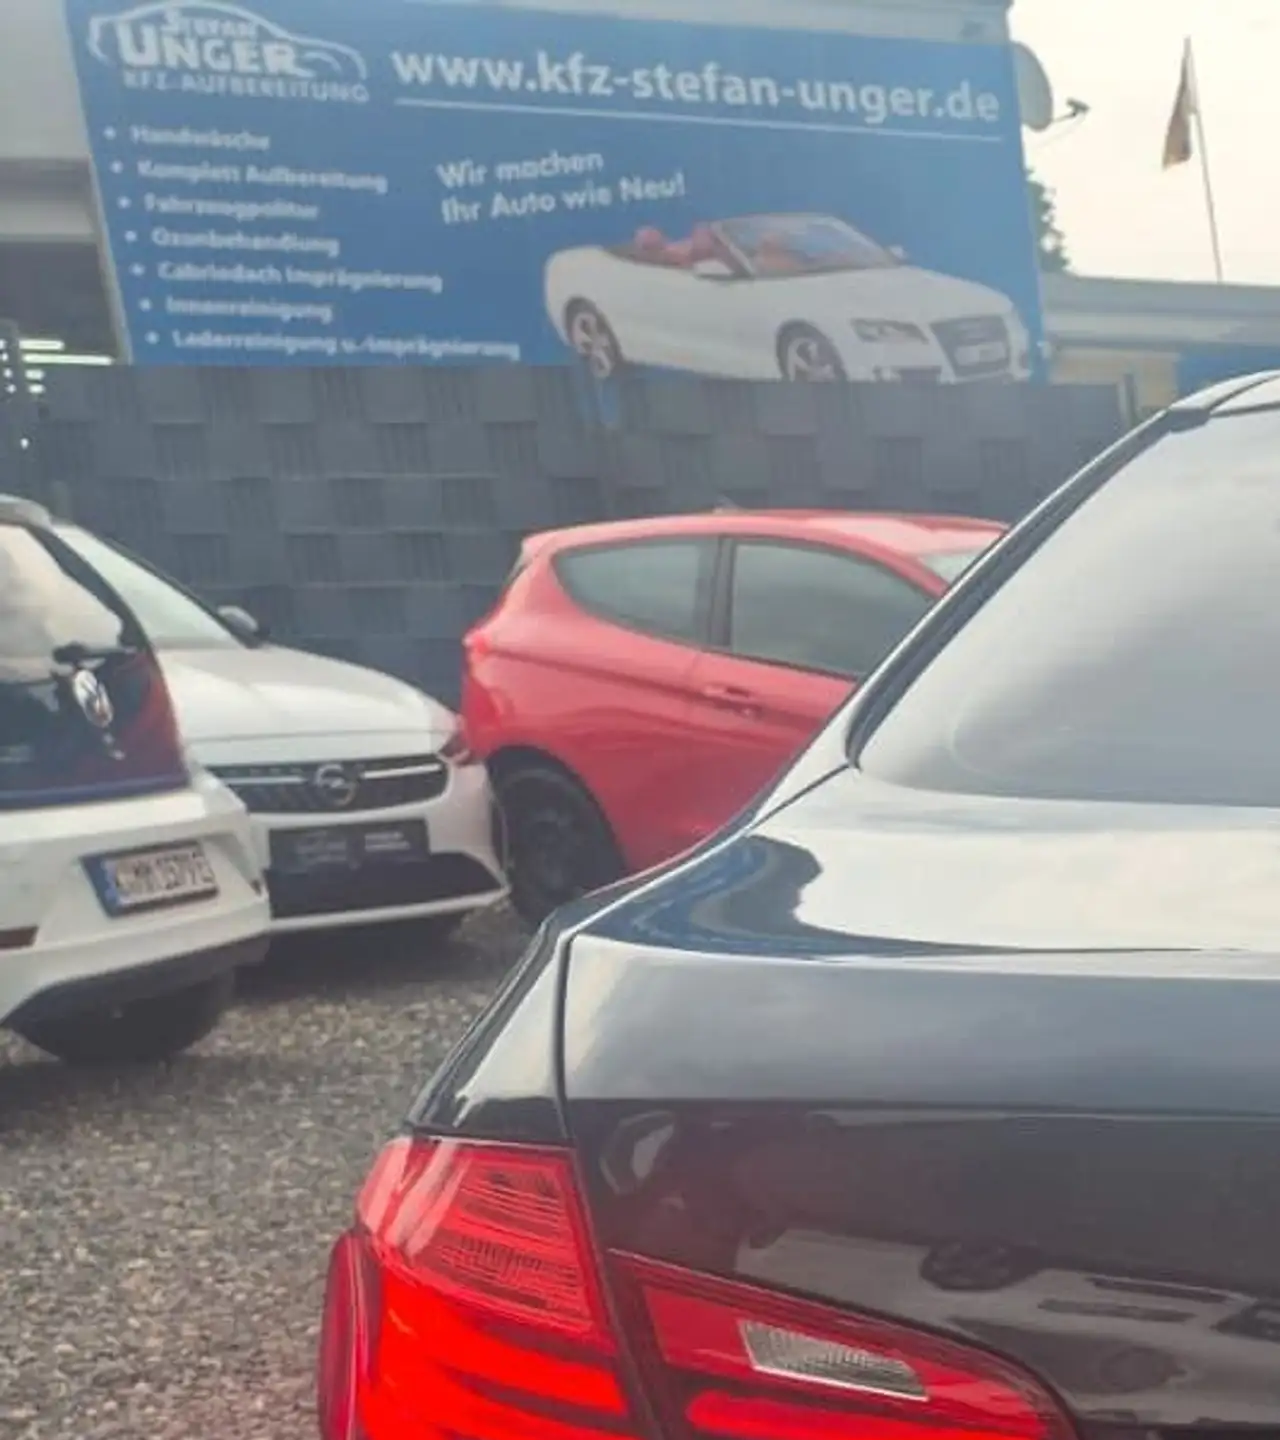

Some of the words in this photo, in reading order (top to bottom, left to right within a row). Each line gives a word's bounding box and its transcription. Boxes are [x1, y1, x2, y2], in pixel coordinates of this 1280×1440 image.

[115, 20, 317, 78] UNGER
[390, 49, 1000, 124] www.kfz-stefan-unger.de
[437, 158, 488, 189] Wir
[495, 150, 604, 182] machen
[441, 195, 482, 225] Ihr
[491, 191, 556, 219] Auto
[561, 181, 613, 209] wie
[619, 169, 686, 201] Neu!
